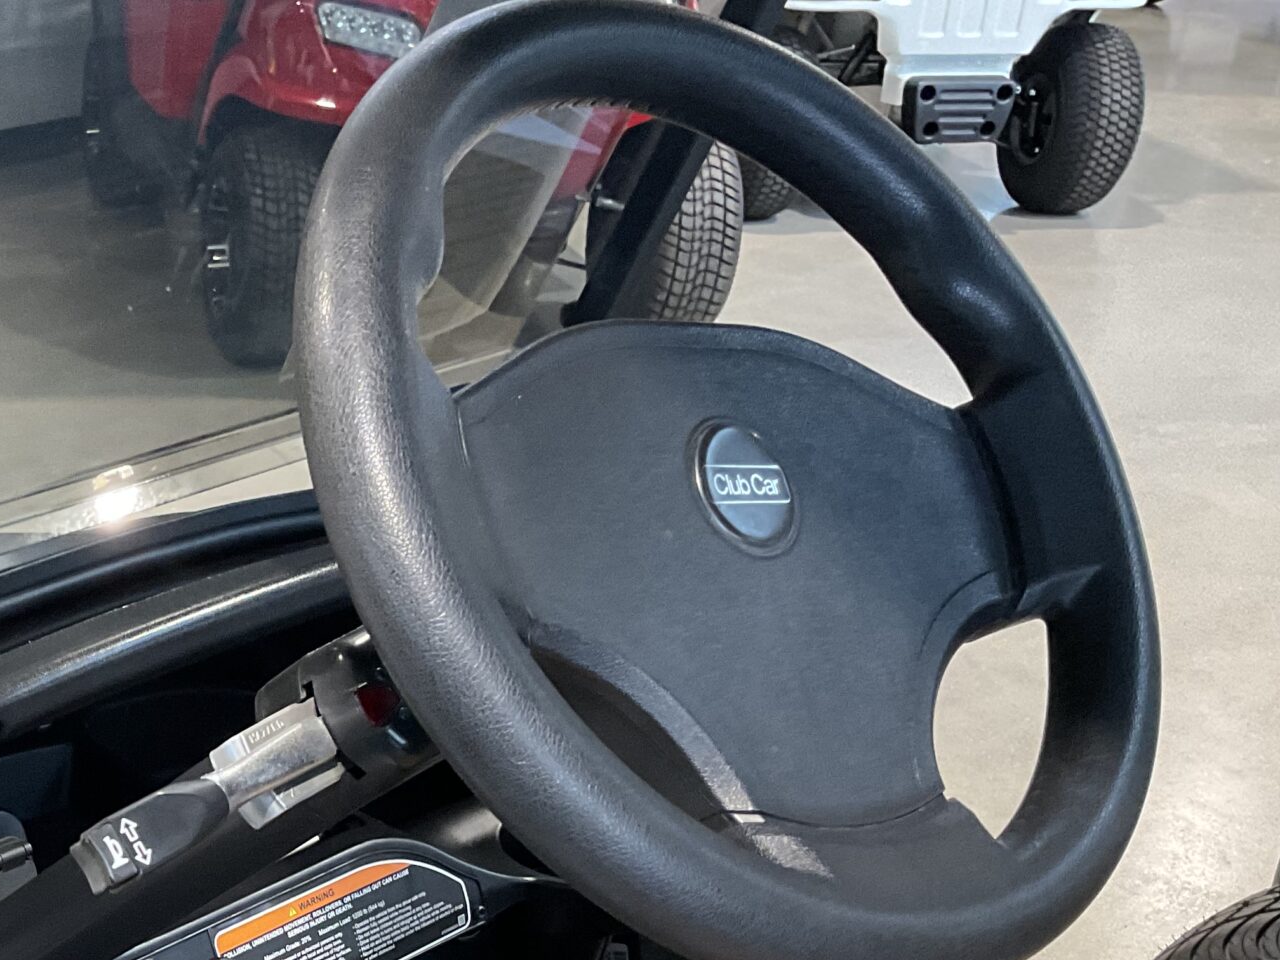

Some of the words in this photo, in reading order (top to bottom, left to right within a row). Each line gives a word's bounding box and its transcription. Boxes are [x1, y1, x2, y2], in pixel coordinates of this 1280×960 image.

[714, 474, 751, 495] Club
[750, 474, 779, 495] Car
[298, 888, 335, 911] WARNING
[343, 896, 351, 905] OR
[372, 881, 382, 891] OUT
[382, 876, 392, 886] CAN
